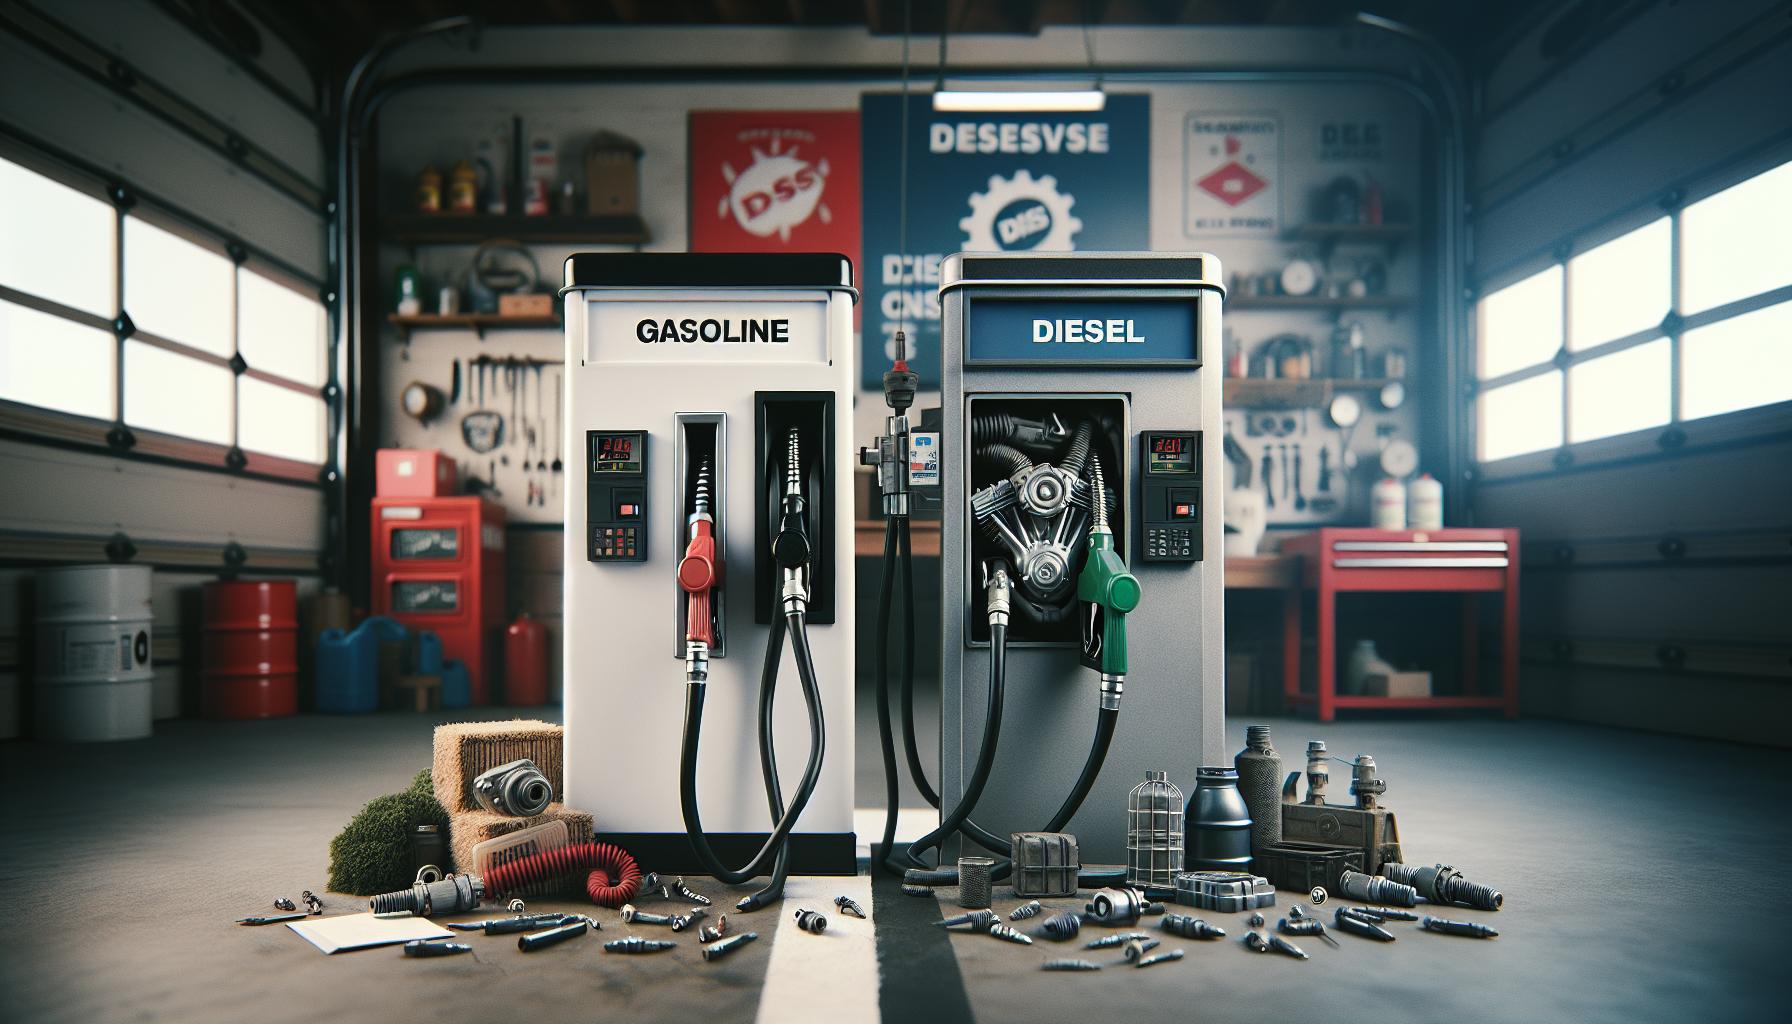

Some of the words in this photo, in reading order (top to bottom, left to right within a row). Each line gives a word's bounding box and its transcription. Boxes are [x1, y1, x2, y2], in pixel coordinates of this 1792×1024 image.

[929, 123, 1109, 153] DESESVSE
[636, 318, 789, 343] GASOLINE
[1032, 319, 1145, 343] DIESEL
